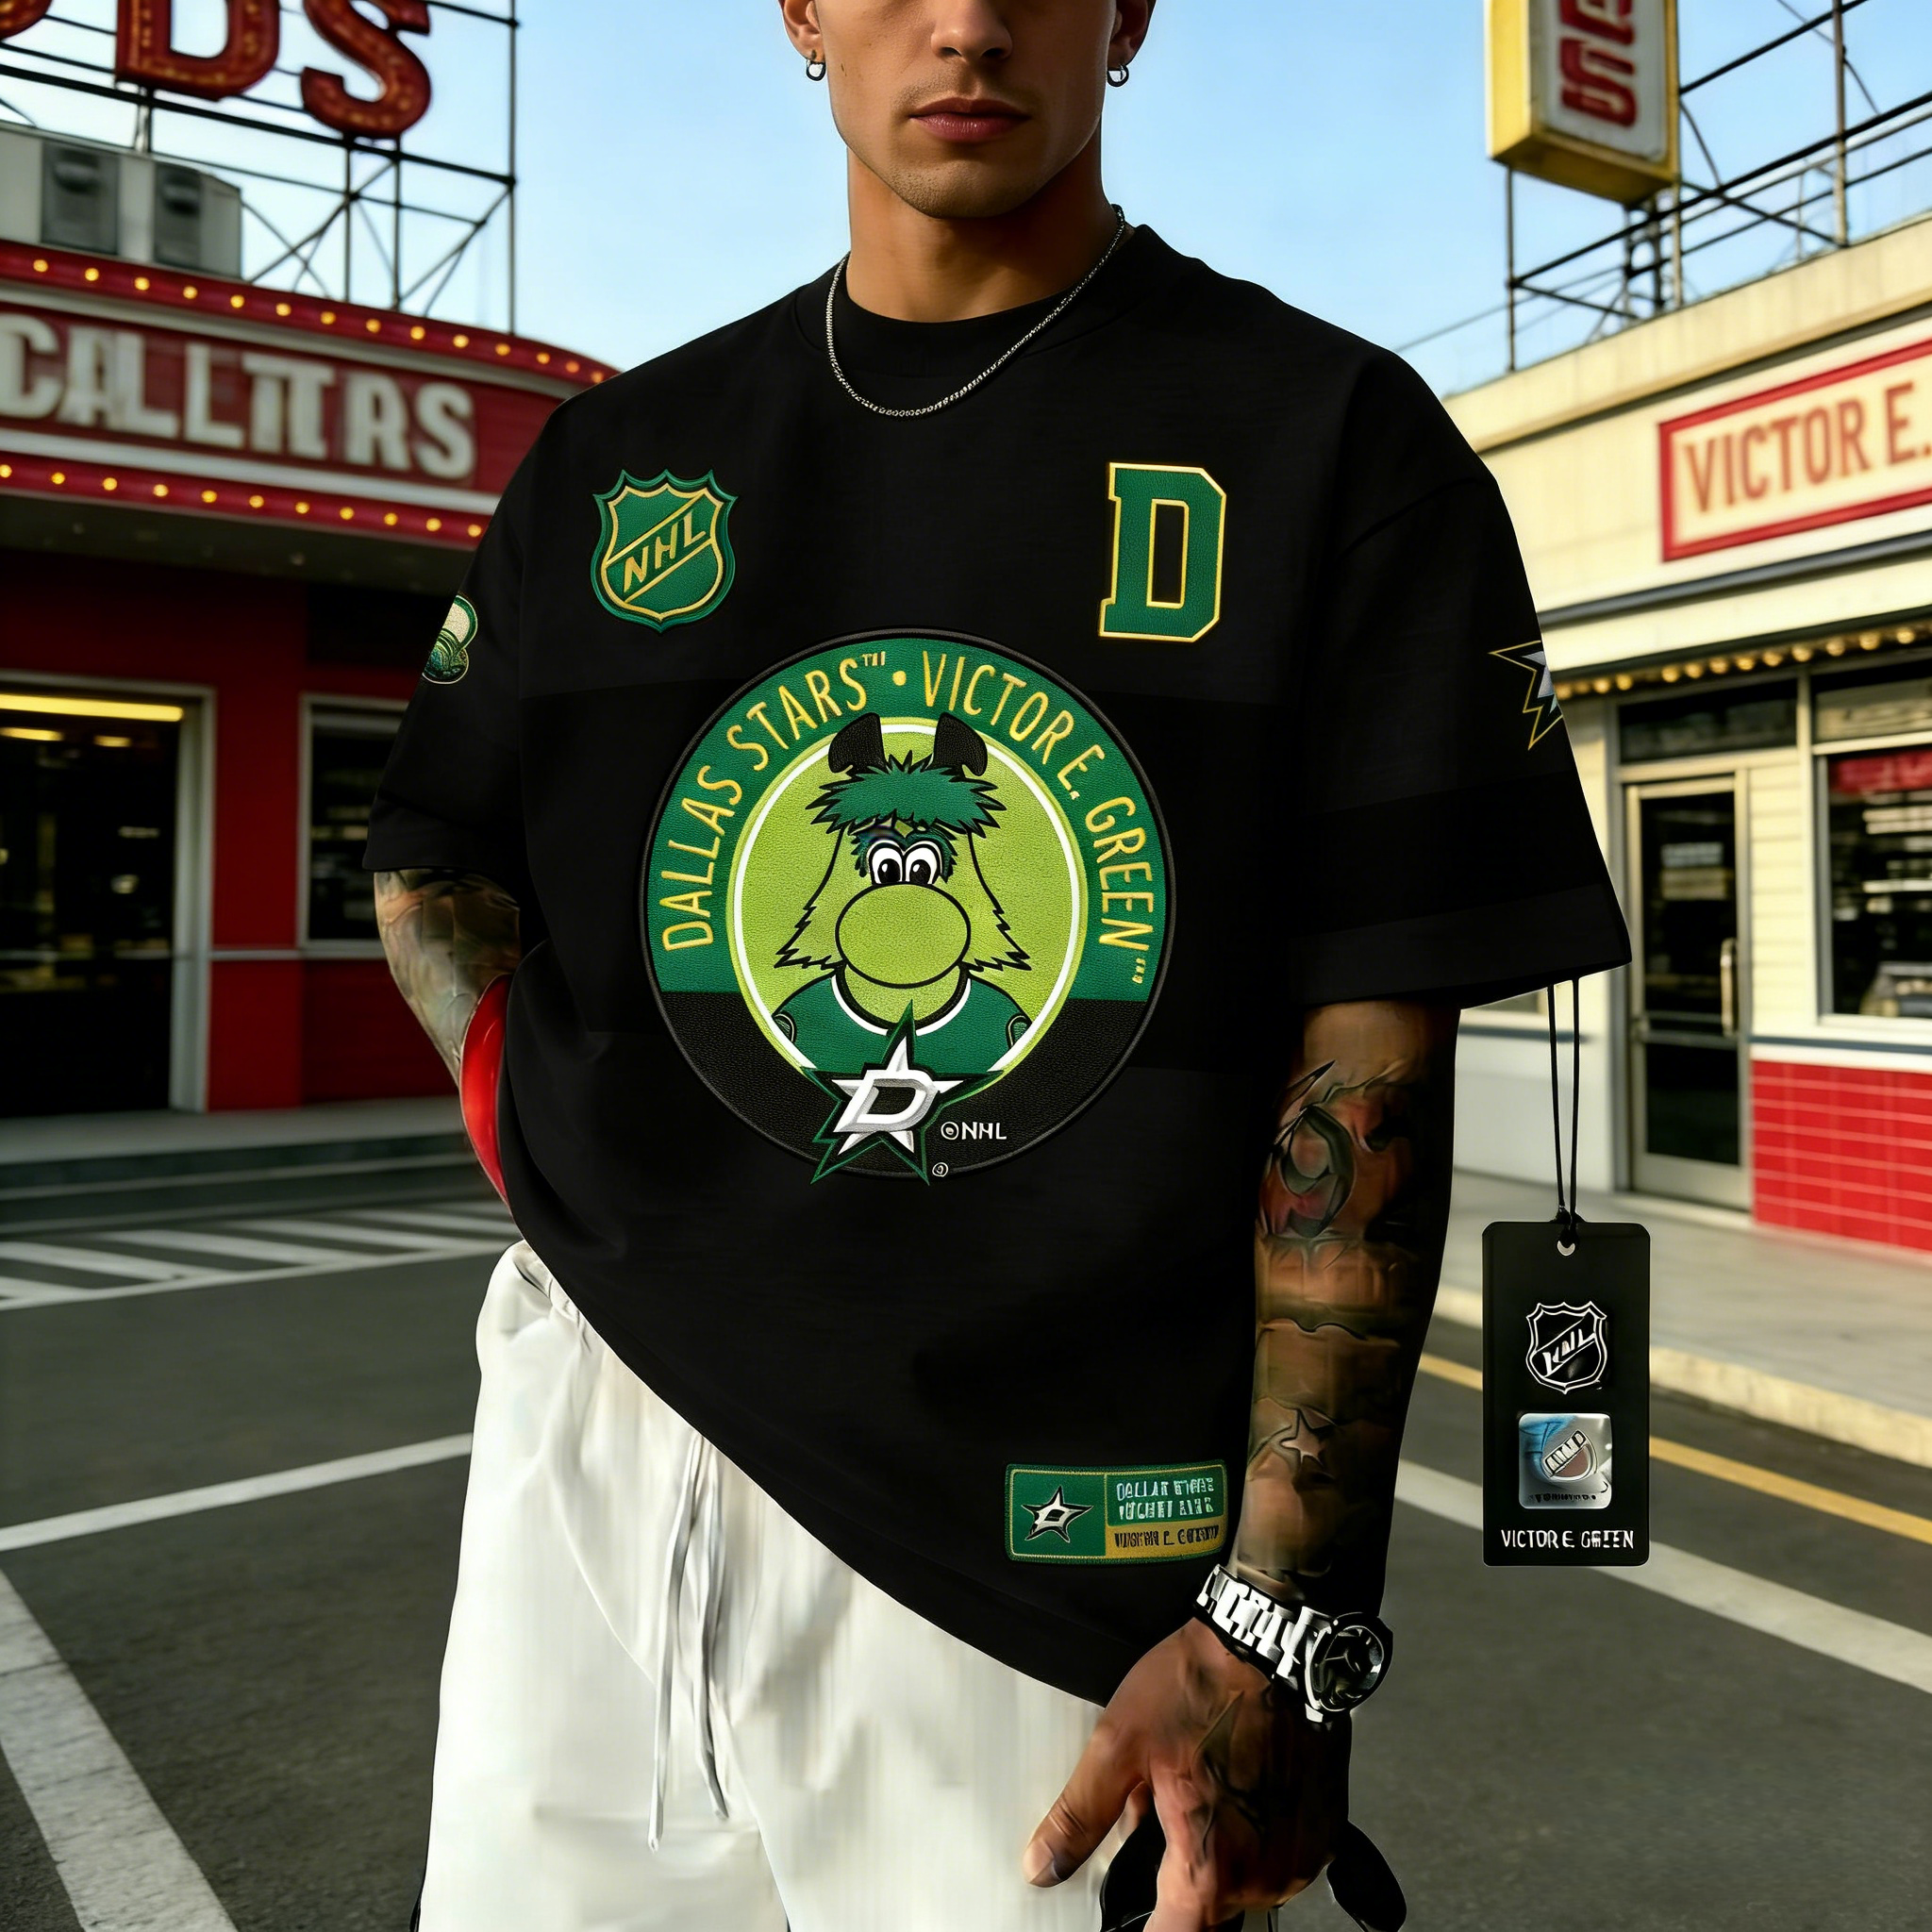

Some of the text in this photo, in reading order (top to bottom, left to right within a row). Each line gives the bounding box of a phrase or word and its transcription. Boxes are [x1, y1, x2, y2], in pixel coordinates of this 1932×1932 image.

[1684, 380, 1932, 512] VICTOR E.
[624, 509, 707, 592] NHL
[1099, 462, 1226, 642] D
[659, 765, 743, 951] DALLAS
[923, 650, 1074, 764] VICTOR
[1058, 743, 1106, 800] E.
[1501, 1529, 1559, 1549] VICTOR
